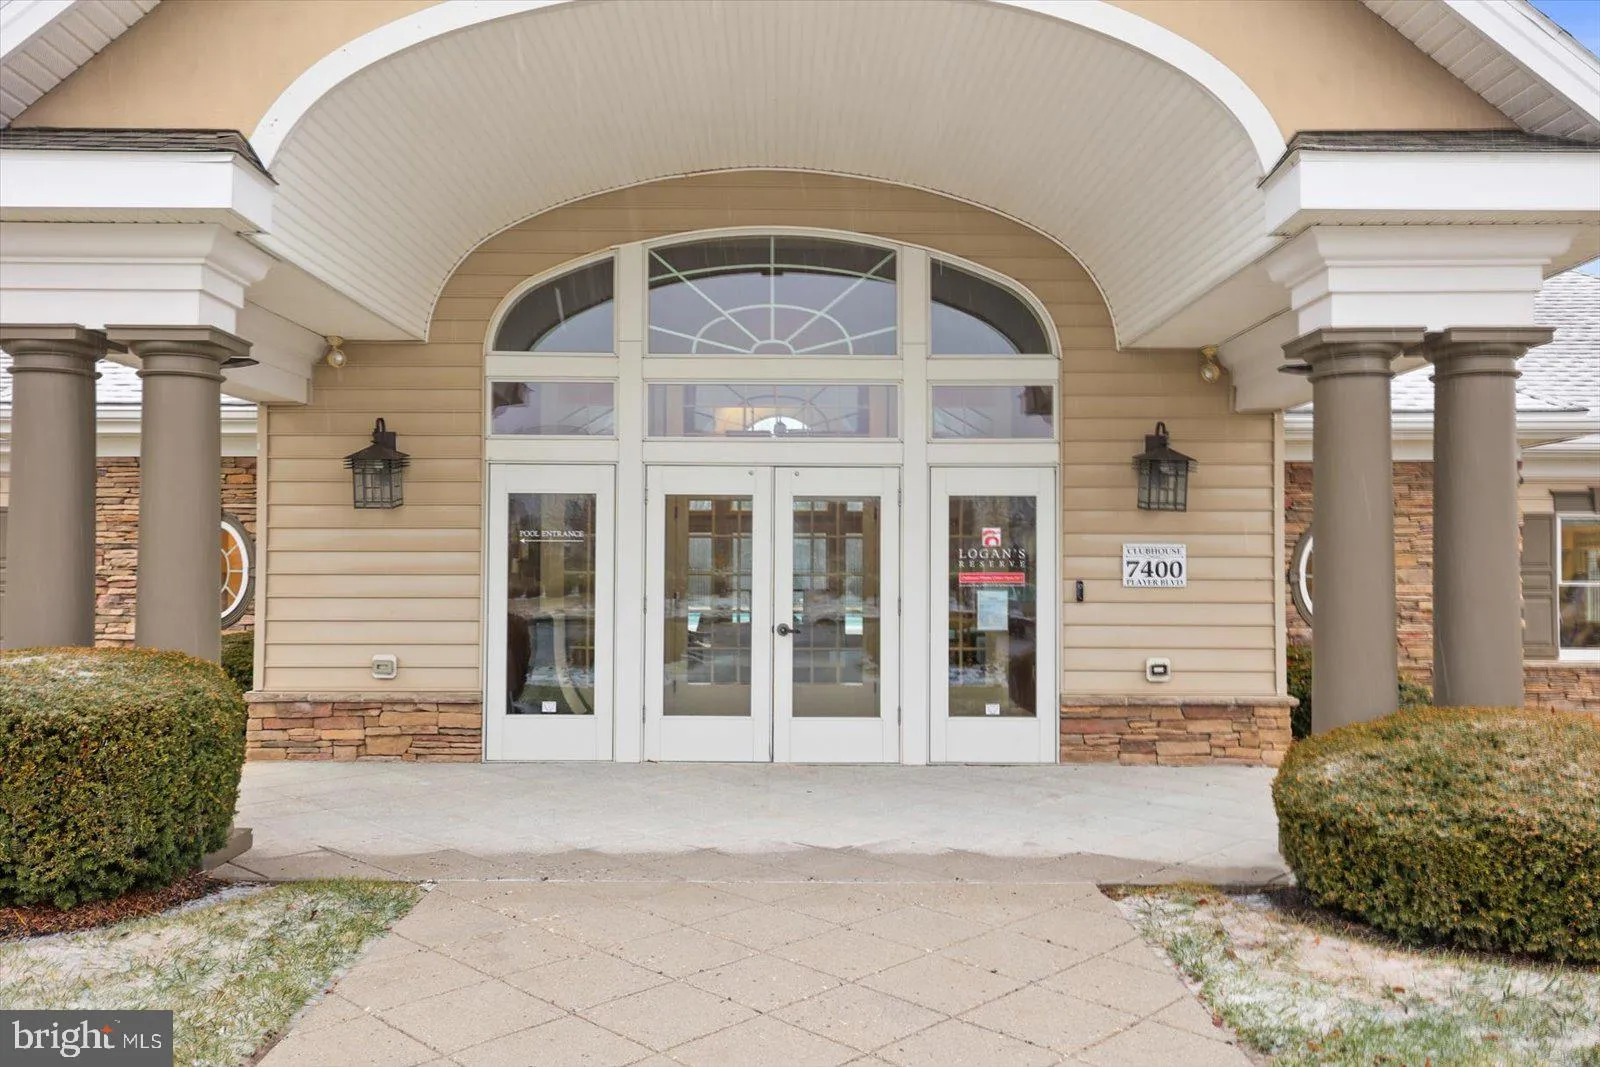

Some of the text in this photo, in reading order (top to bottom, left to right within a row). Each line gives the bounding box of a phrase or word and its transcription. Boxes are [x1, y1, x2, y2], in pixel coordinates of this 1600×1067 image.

[958, 548, 1026, 559] LOGAN'S
[958, 560, 1026, 568] RESERVE
[1126, 560, 1183, 579] 7400
